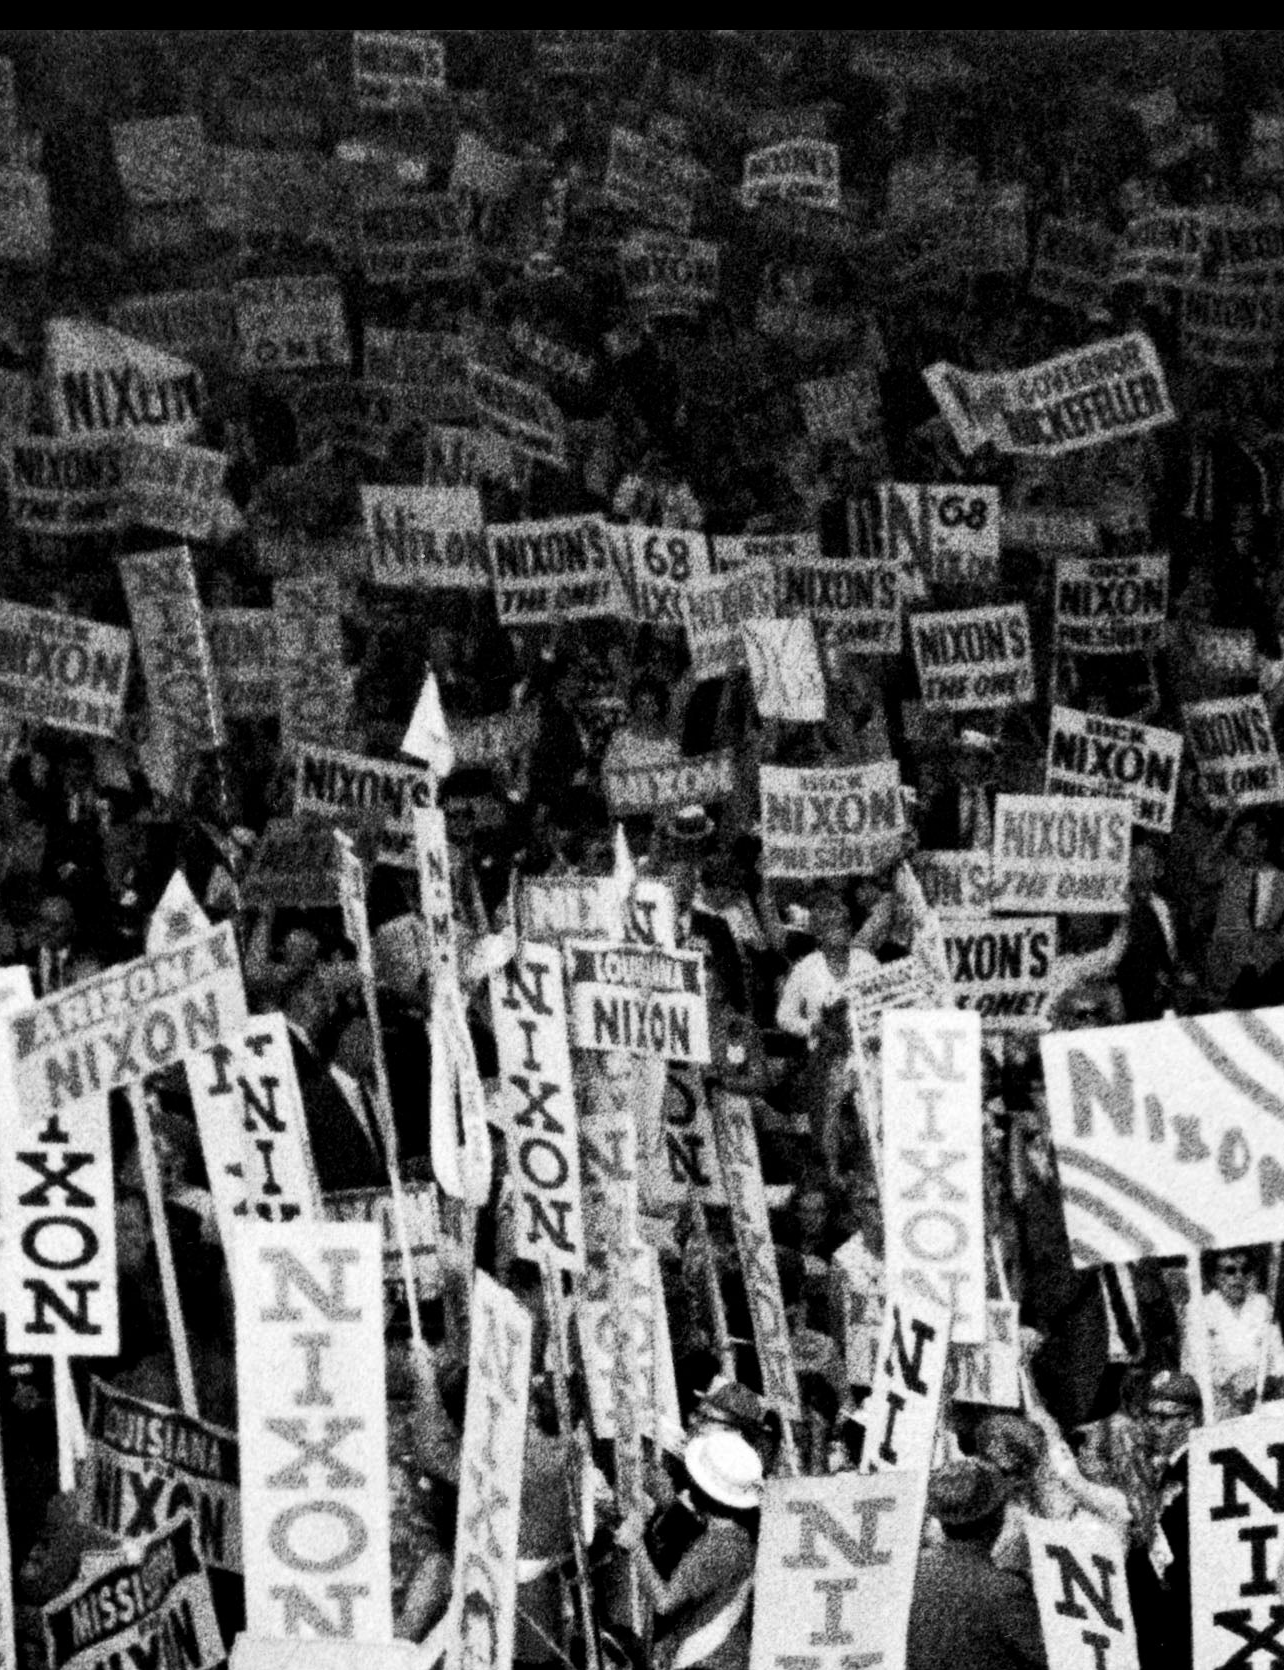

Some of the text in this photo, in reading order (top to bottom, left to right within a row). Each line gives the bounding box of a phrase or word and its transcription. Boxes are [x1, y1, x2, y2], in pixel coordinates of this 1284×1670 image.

[643, 536, 691, 580] 68
[1058, 579, 1165, 619] NIXON
[1050, 731, 1175, 792] NIXON
[765, 789, 903, 834] NIXON
[45, 991, 226, 1102] NIXON
[589, 997, 694, 1055] NIXON
[503, 959, 577, 1253] NIXON
[16, 1116, 105, 1338] XON
[255, 1245, 371, 1639] NIXON
